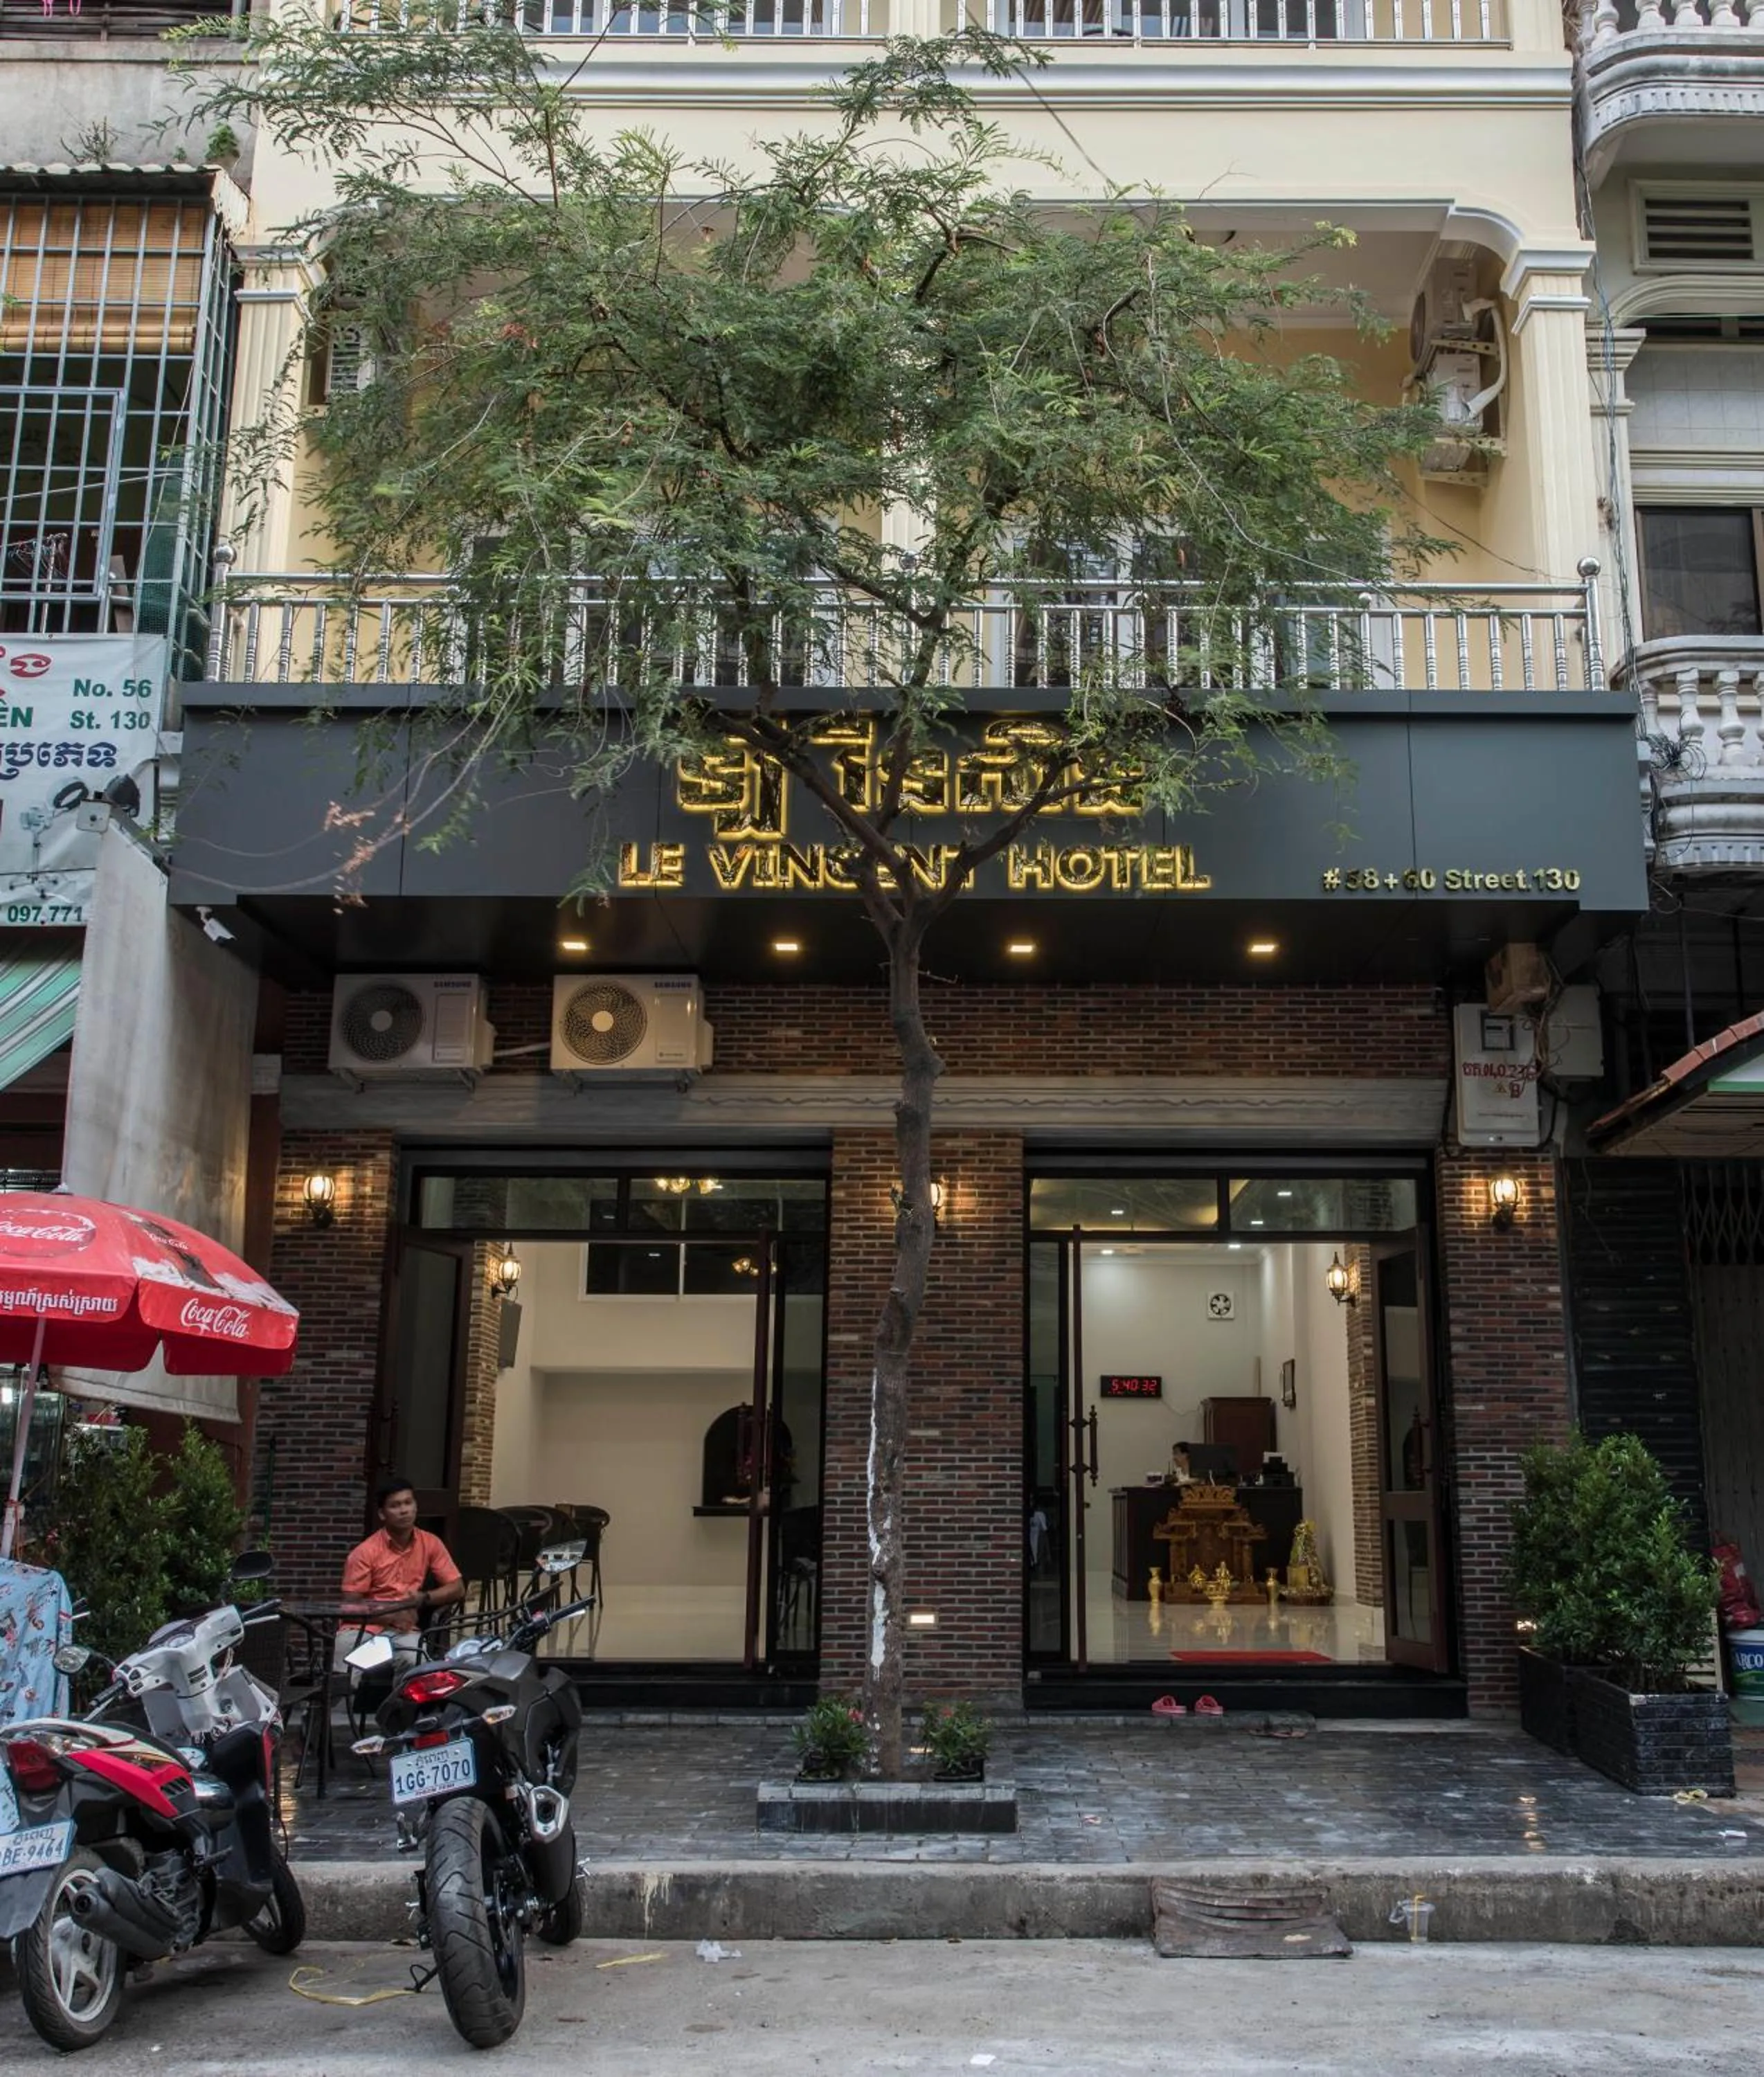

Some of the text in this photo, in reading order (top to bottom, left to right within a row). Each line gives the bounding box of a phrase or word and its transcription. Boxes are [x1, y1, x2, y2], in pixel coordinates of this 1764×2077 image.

[73, 678, 152, 698] No. 56
[70, 710, 151, 730] St. 130
[619, 842, 684, 887] LE
[1008, 843, 1212, 891] HOTEL
[8, 905, 42, 923] 097
[181, 1297, 252, 1338] Coca-Cola
[0, 1838, 64, 1866] BE-9464
